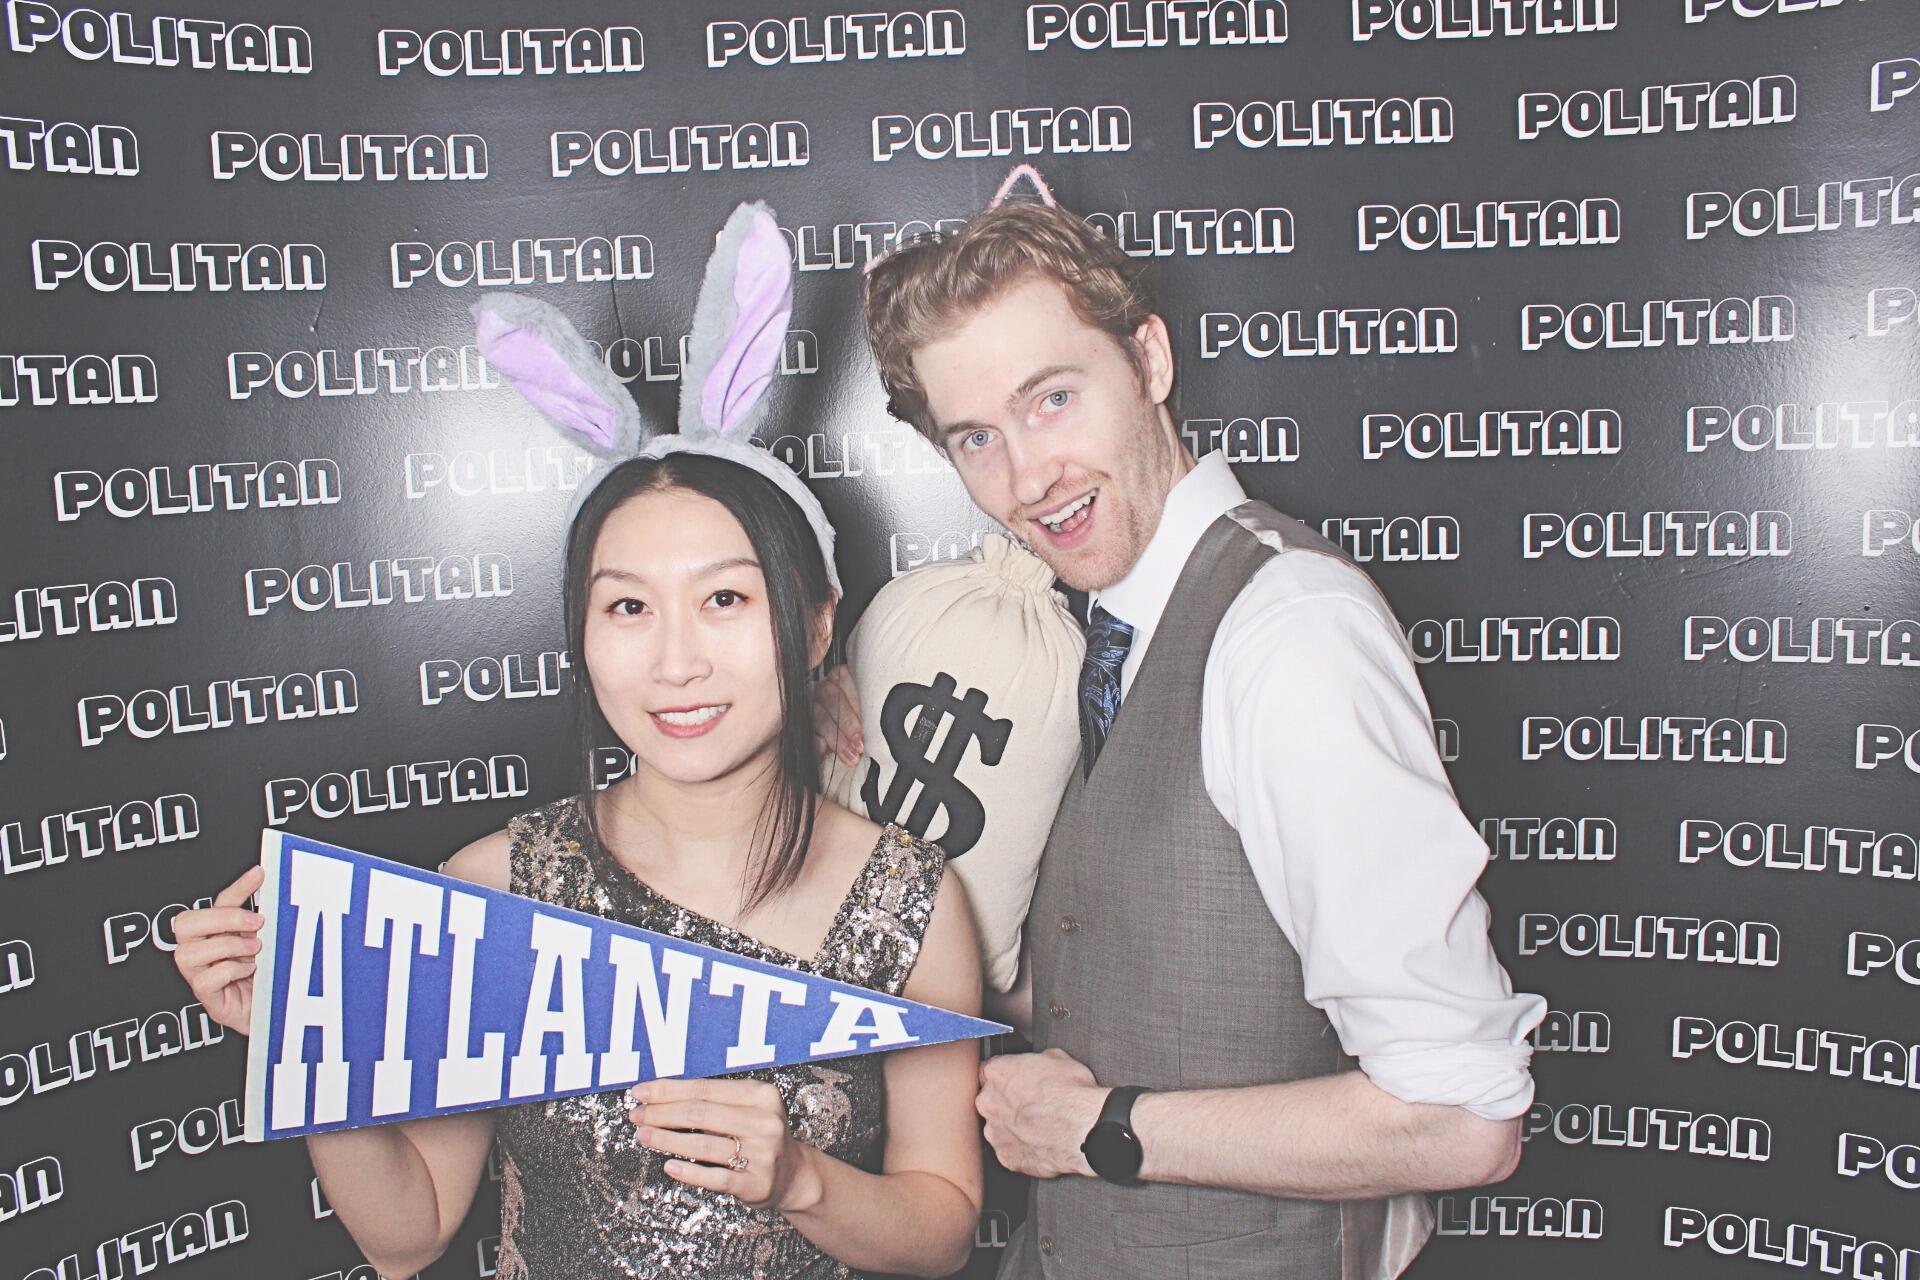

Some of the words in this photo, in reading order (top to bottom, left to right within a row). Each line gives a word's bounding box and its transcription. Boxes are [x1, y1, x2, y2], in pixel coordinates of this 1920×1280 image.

[7, 0, 313, 74] POLITAN
[706, 9, 967, 68] POLITAN
[1026, 0, 1288, 51] POLITAN
[1353, 0, 1619, 41] POLITAN
[378, 26, 645, 76] POLITAN
[871, 105, 1132, 162] POLITAN
[1193, 96, 1454, 149] POLITAN
[1518, 74, 1797, 140] POLITAN
[211, 131, 488, 181] POLITAN
[550, 121, 810, 178] POLITAN
[1358, 198, 1621, 252] POLITAN
[33, 239, 326, 291] POLITAN
[390, 235, 655, 289] POLITAN
[1200, 307, 1458, 357] POLITAN
[1521, 295, 1795, 351] POLITAN
[1362, 409, 1622, 461] POLITAN
[54, 457, 341, 522] POLITAN
[1523, 510, 1793, 559] POLITAN
[245, 553, 514, 617] POLITAN
[1397, 615, 1621, 664] OLITAN
[419, 651, 571, 706] POLI
[78, 668, 358, 747] POLITAN
[1522, 716, 1788, 765] POLITAN
[264, 754, 530, 826] POLITAN
[1679, 819, 1920, 881] POLITA
[1518, 914, 1780, 967] POLITAN
[272, 850, 919, 1130] ATLANTA
[1673, 1016, 1920, 1090] POLITA
